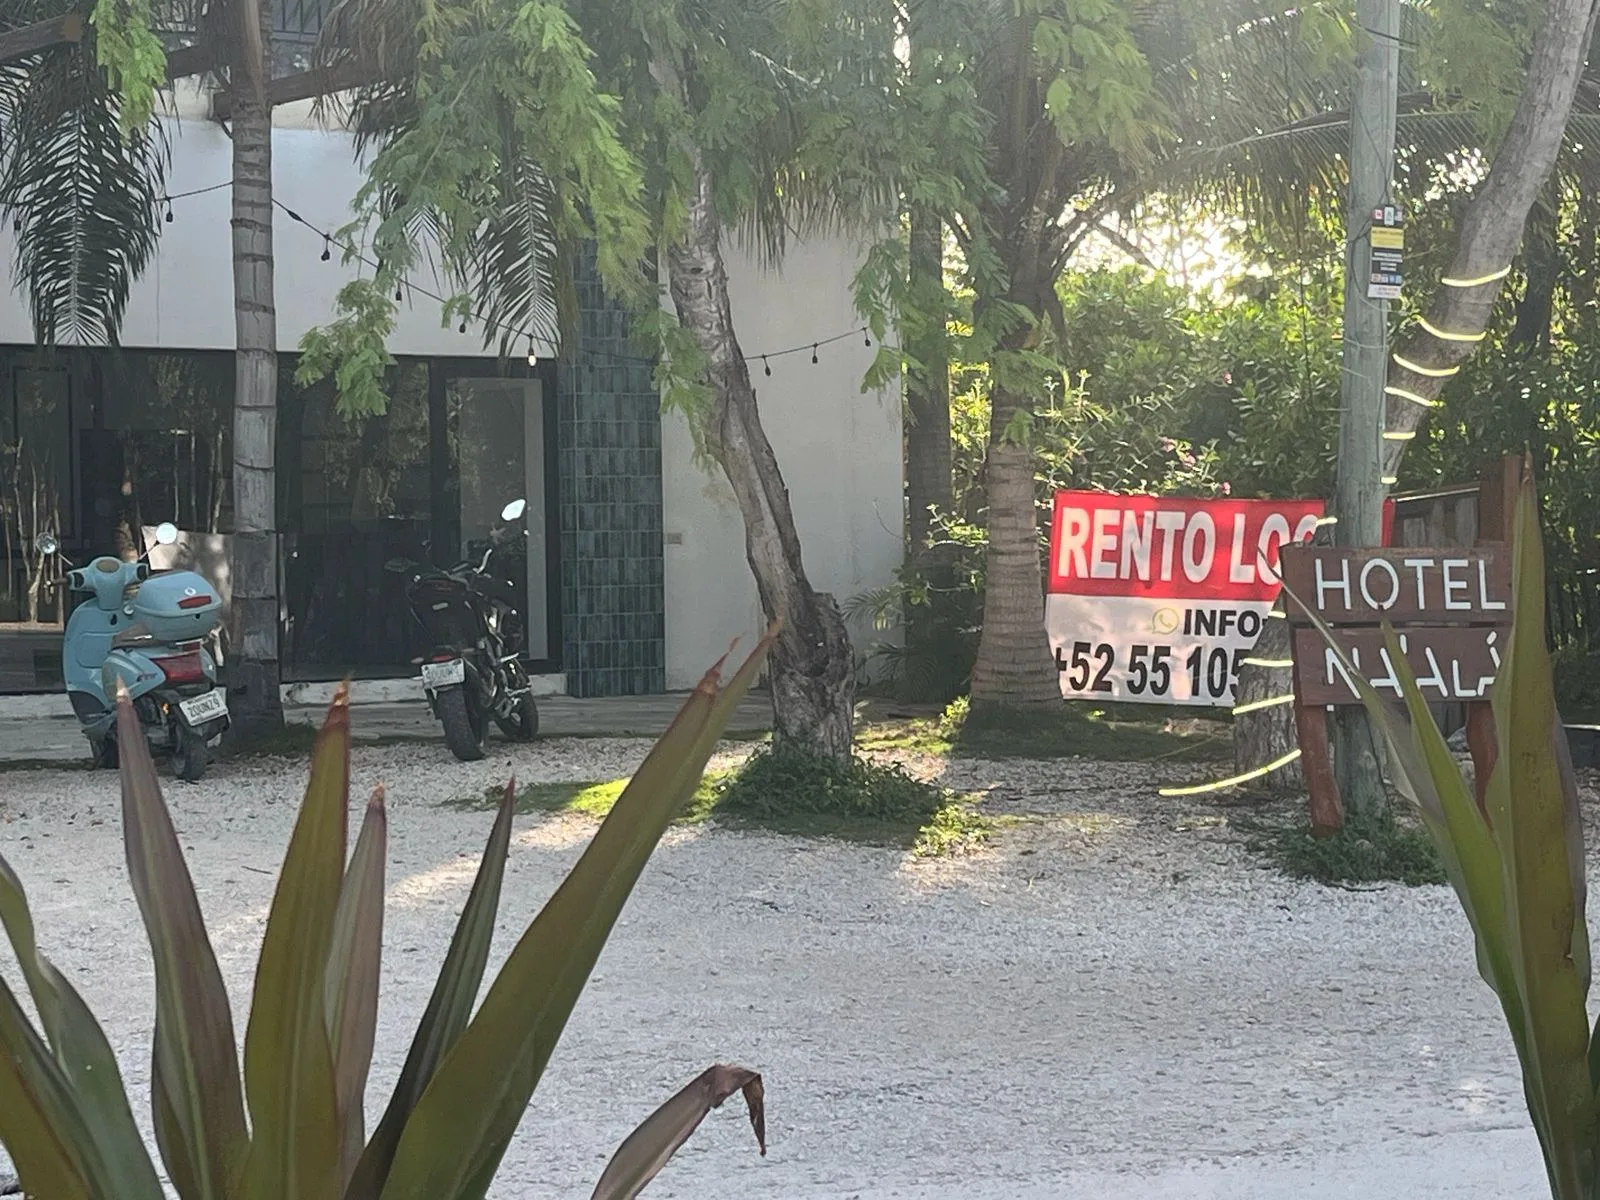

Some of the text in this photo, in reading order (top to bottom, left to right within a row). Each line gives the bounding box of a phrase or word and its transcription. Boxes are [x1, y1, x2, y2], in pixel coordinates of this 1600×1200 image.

[1057, 507, 1216, 584] RENTO
[1315, 558, 1506, 610] HOTEL
[1127, 645, 1171, 696] 55
